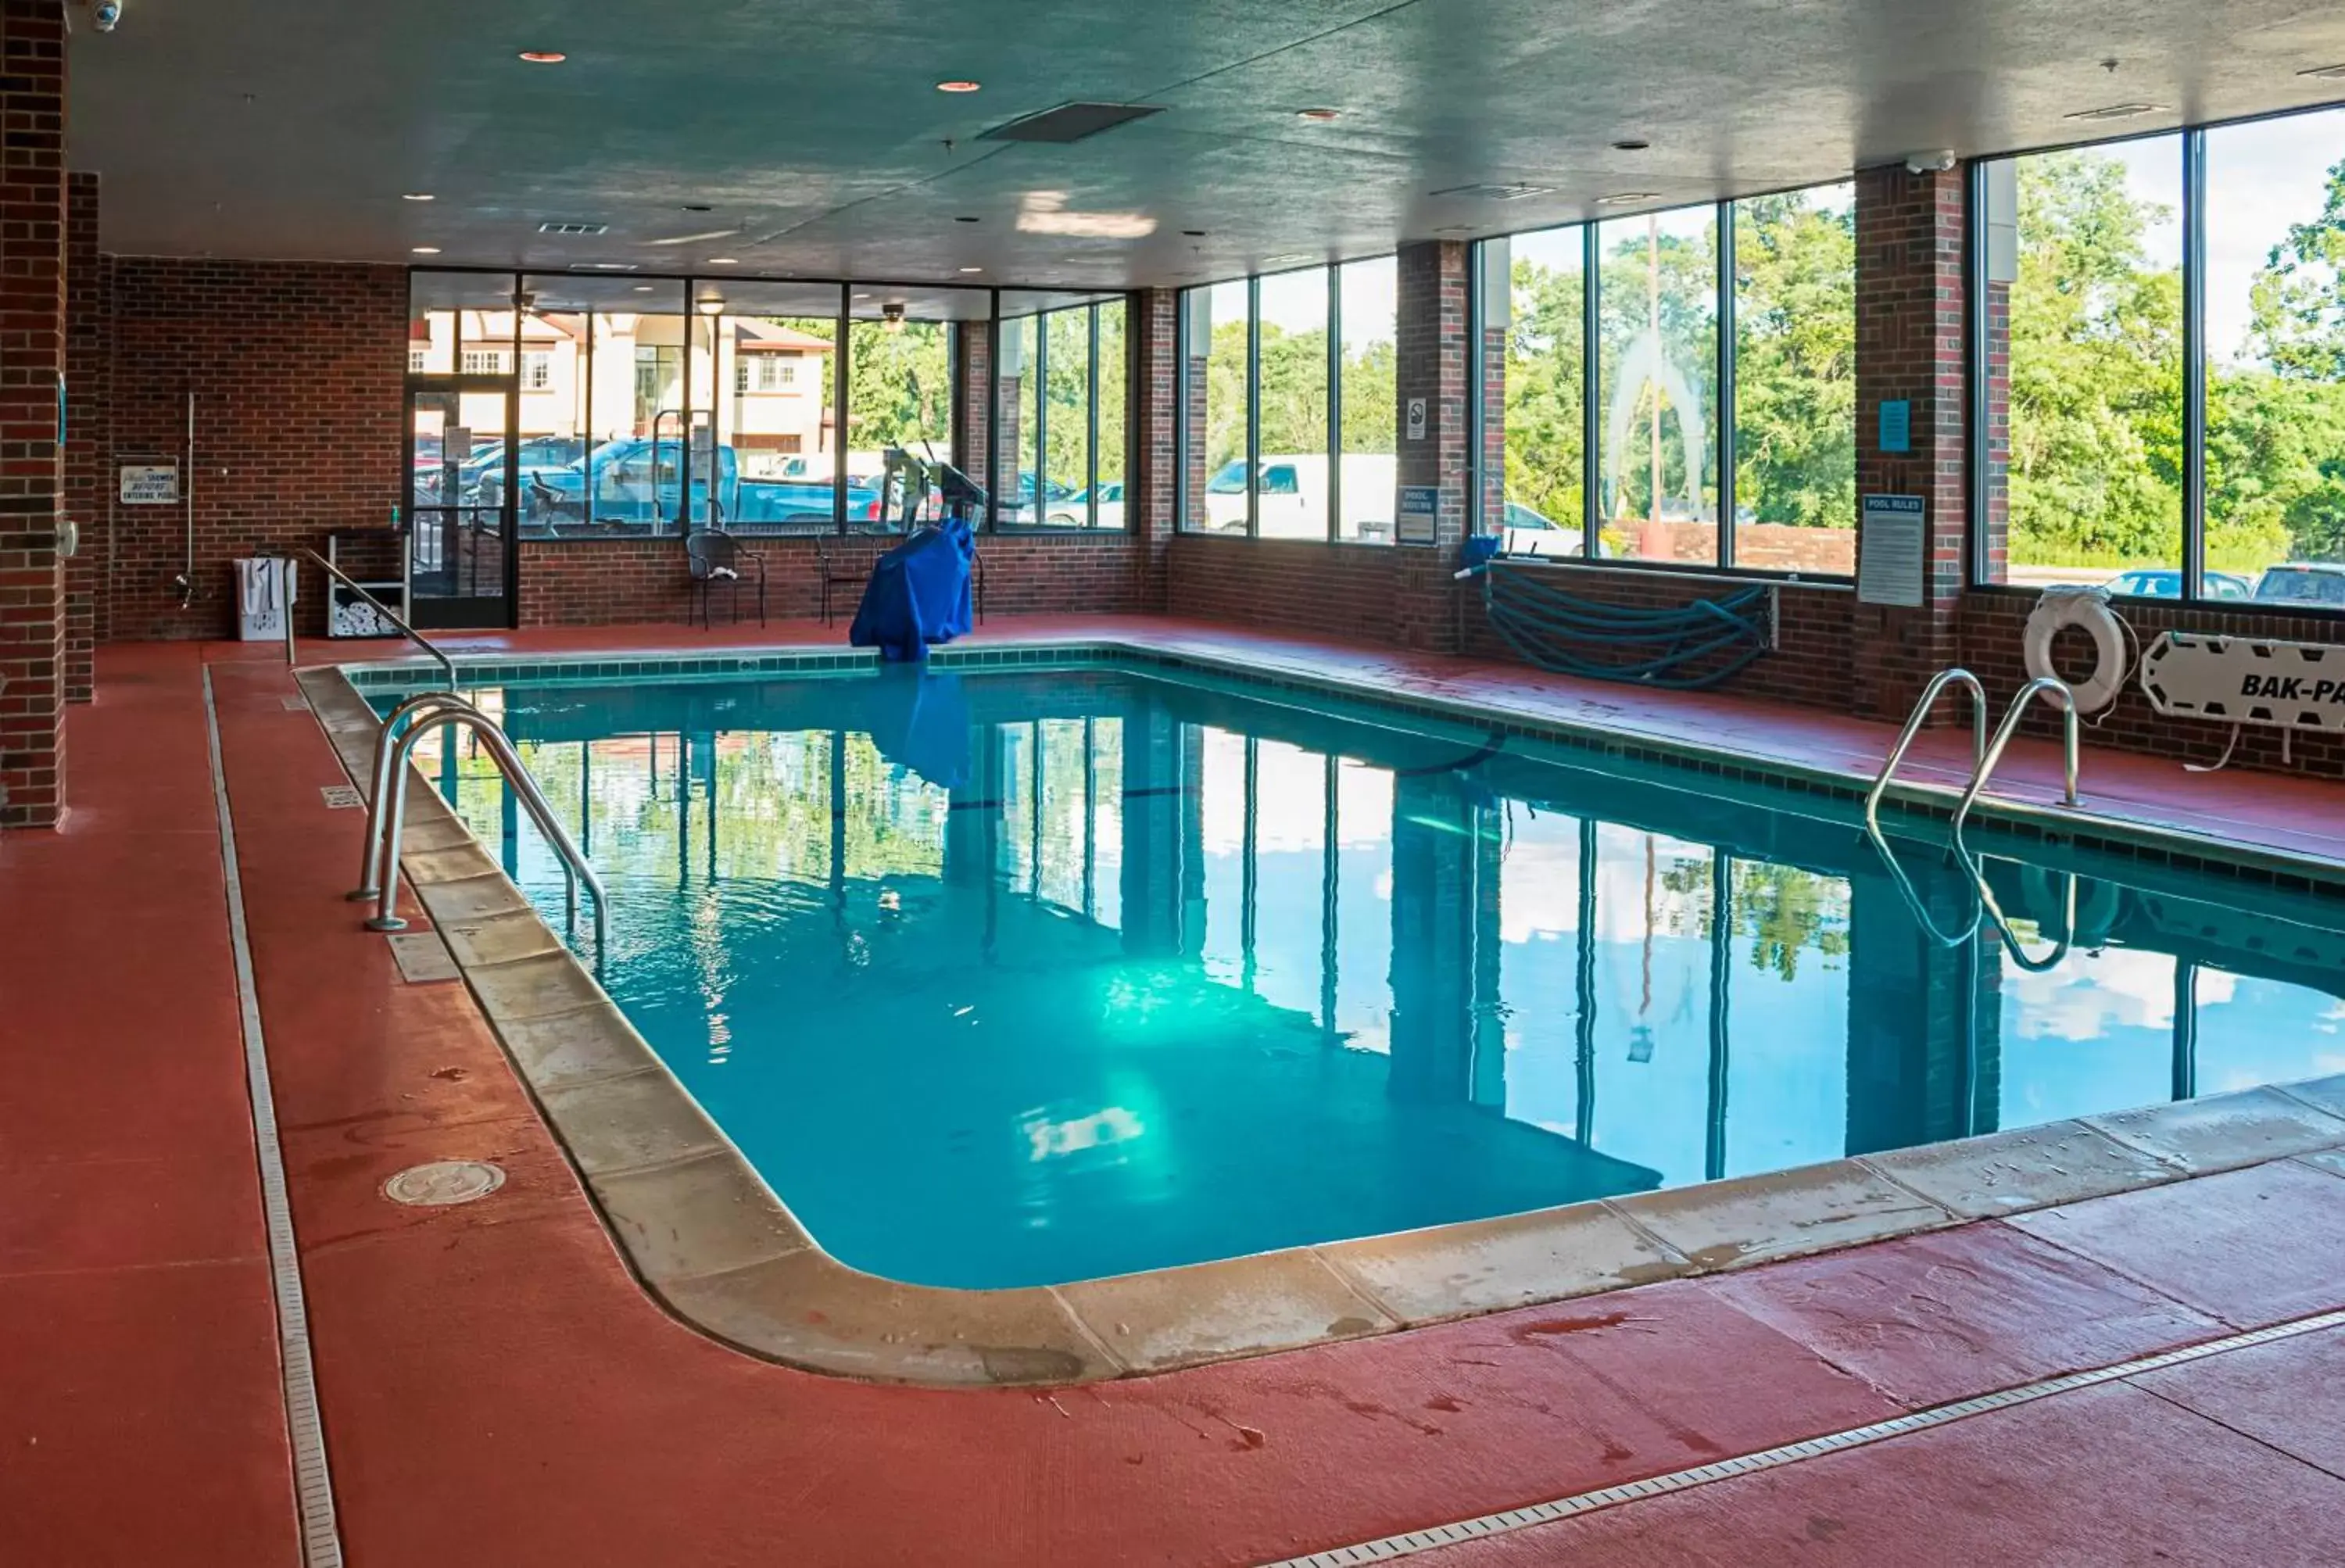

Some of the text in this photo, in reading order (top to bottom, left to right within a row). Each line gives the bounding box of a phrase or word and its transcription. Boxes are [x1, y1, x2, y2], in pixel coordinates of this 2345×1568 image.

[1405, 490, 1429, 500] POOL
[1868, 499, 1920, 510] POOL RULES
